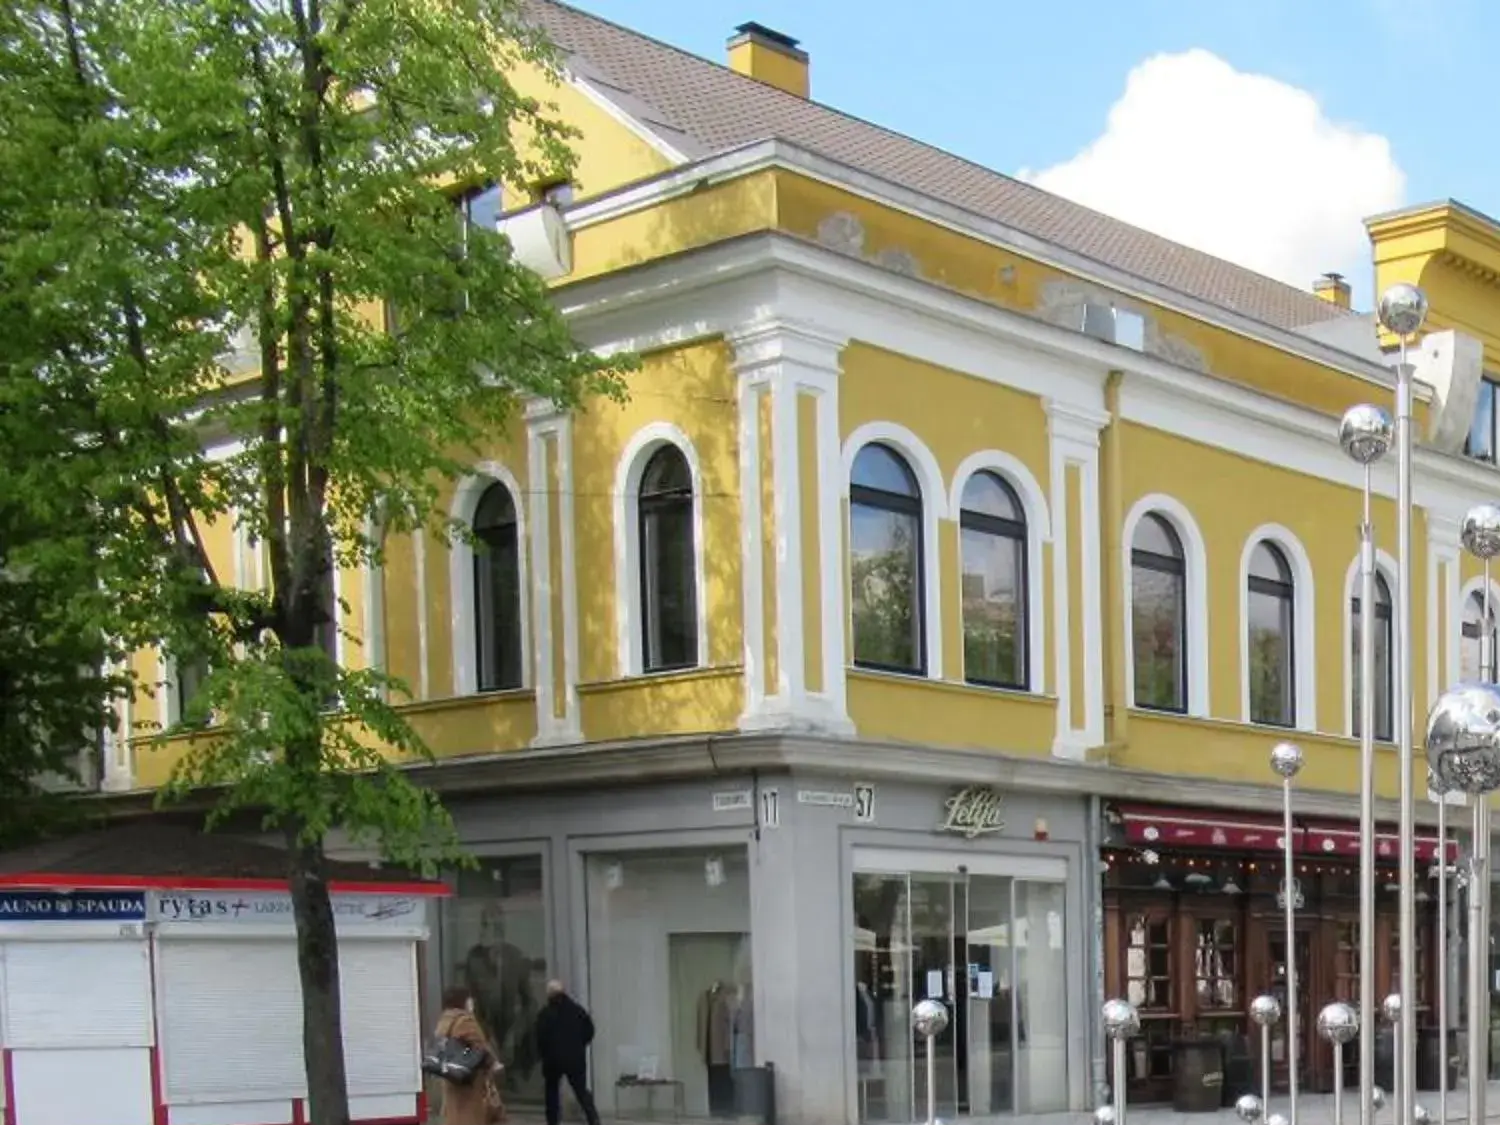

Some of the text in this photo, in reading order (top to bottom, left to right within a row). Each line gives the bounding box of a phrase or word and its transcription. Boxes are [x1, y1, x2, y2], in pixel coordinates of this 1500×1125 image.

[762, 791, 778, 825] 17
[855, 787, 874, 818] 57
[75, 898, 145, 913] SPAUDA
